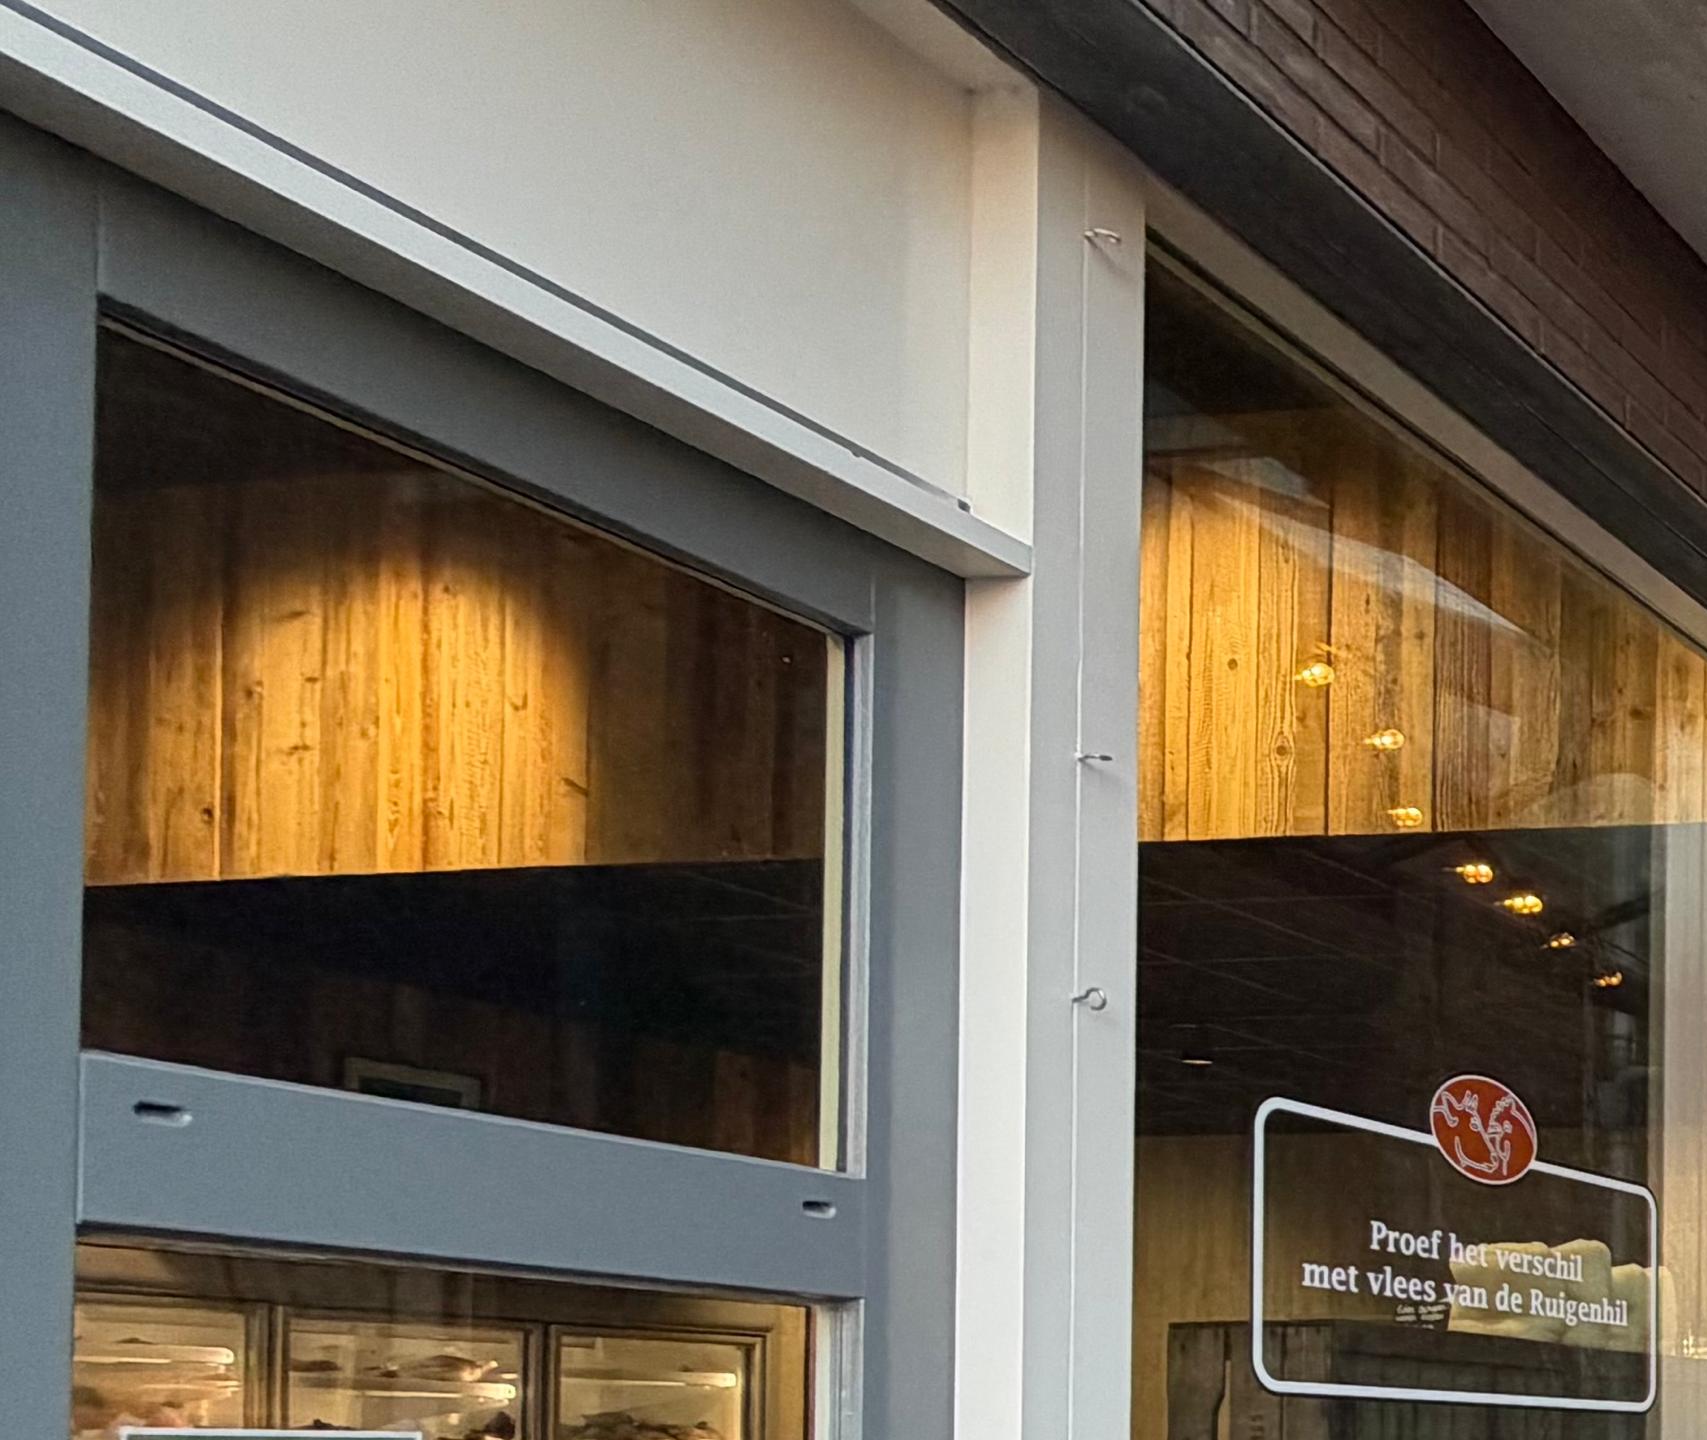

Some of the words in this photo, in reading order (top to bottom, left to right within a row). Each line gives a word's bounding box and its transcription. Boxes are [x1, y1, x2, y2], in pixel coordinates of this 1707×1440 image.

[1369, 1220, 1443, 1260] Proef
[1449, 1232, 1489, 1268] het
[1494, 1249, 1584, 1283] verschil
[1301, 1261, 1360, 1294] met
[1366, 1266, 1437, 1303] vlees
[1443, 1282, 1489, 1310] van
[1494, 1283, 1523, 1314] de
[1529, 1289, 1629, 1328] Ruigenhil
